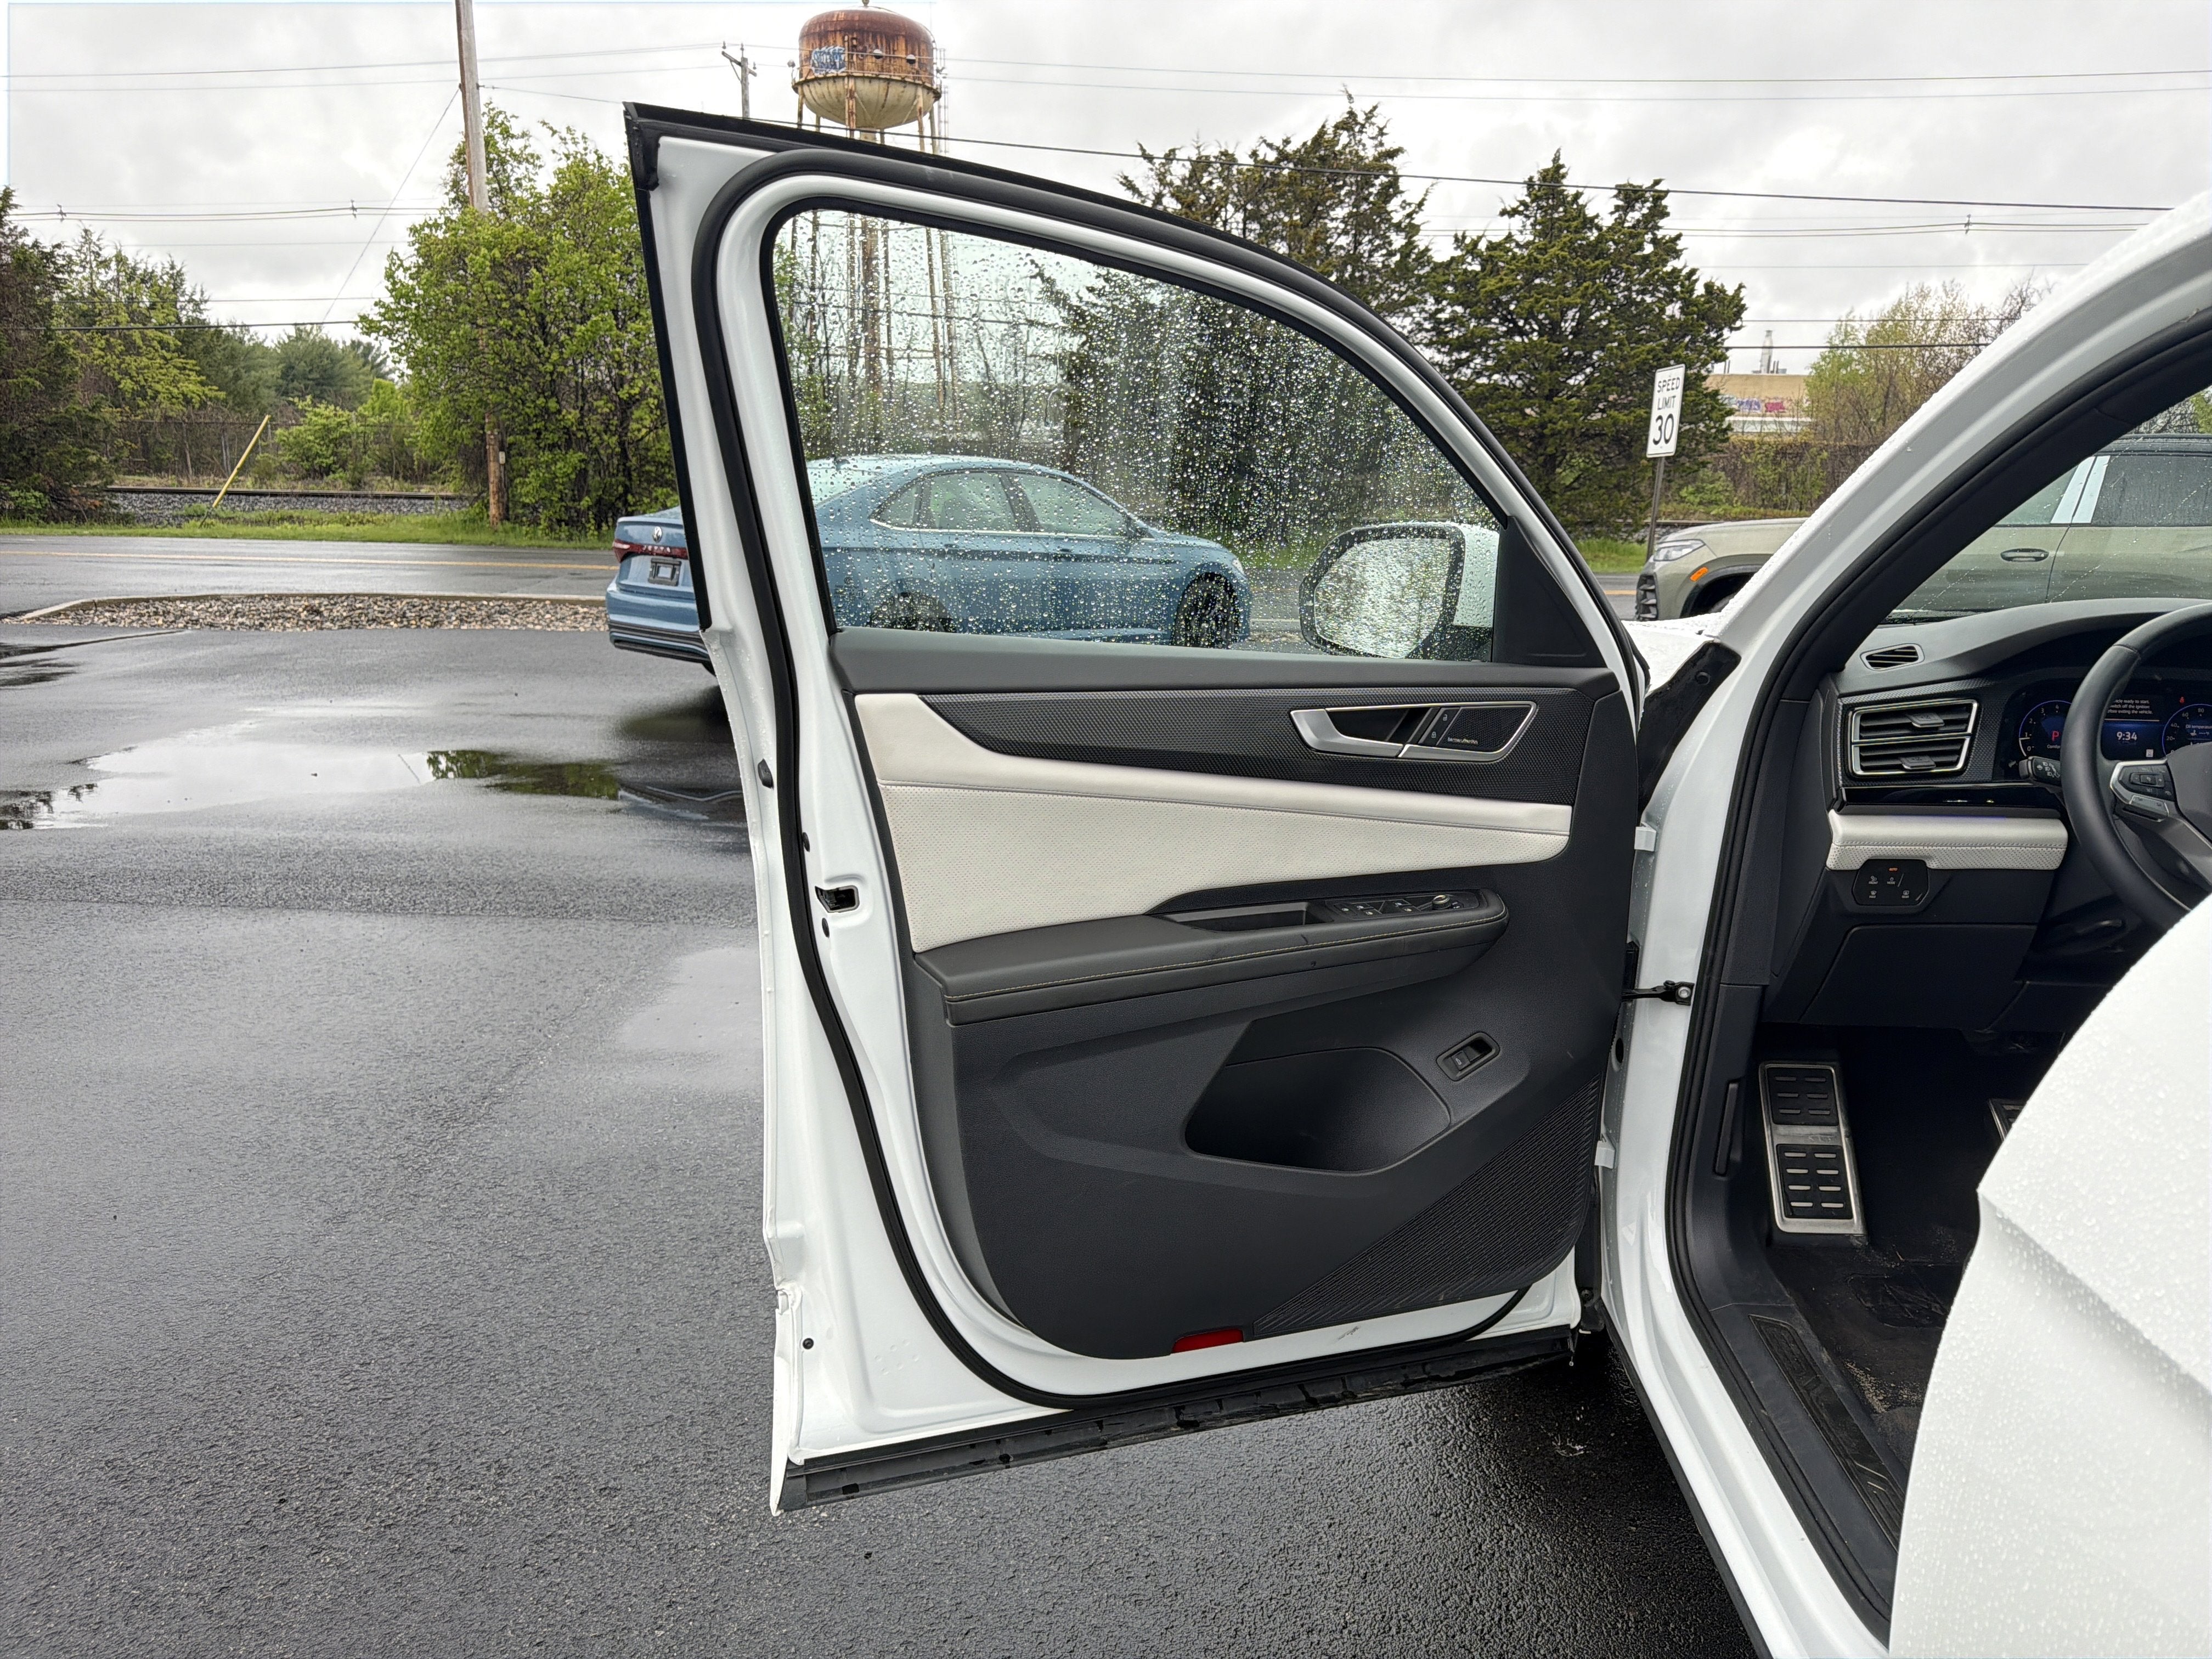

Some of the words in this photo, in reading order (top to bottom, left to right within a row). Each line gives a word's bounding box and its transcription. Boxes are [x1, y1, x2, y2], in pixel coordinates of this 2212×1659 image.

[1657, 377, 1680, 393] SPEED
[1657, 396, 1676, 410] LIMIT
[1652, 413, 1674, 445] 30
[2052, 731, 2059, 741] P
[2117, 731, 2137, 741] 9:34
